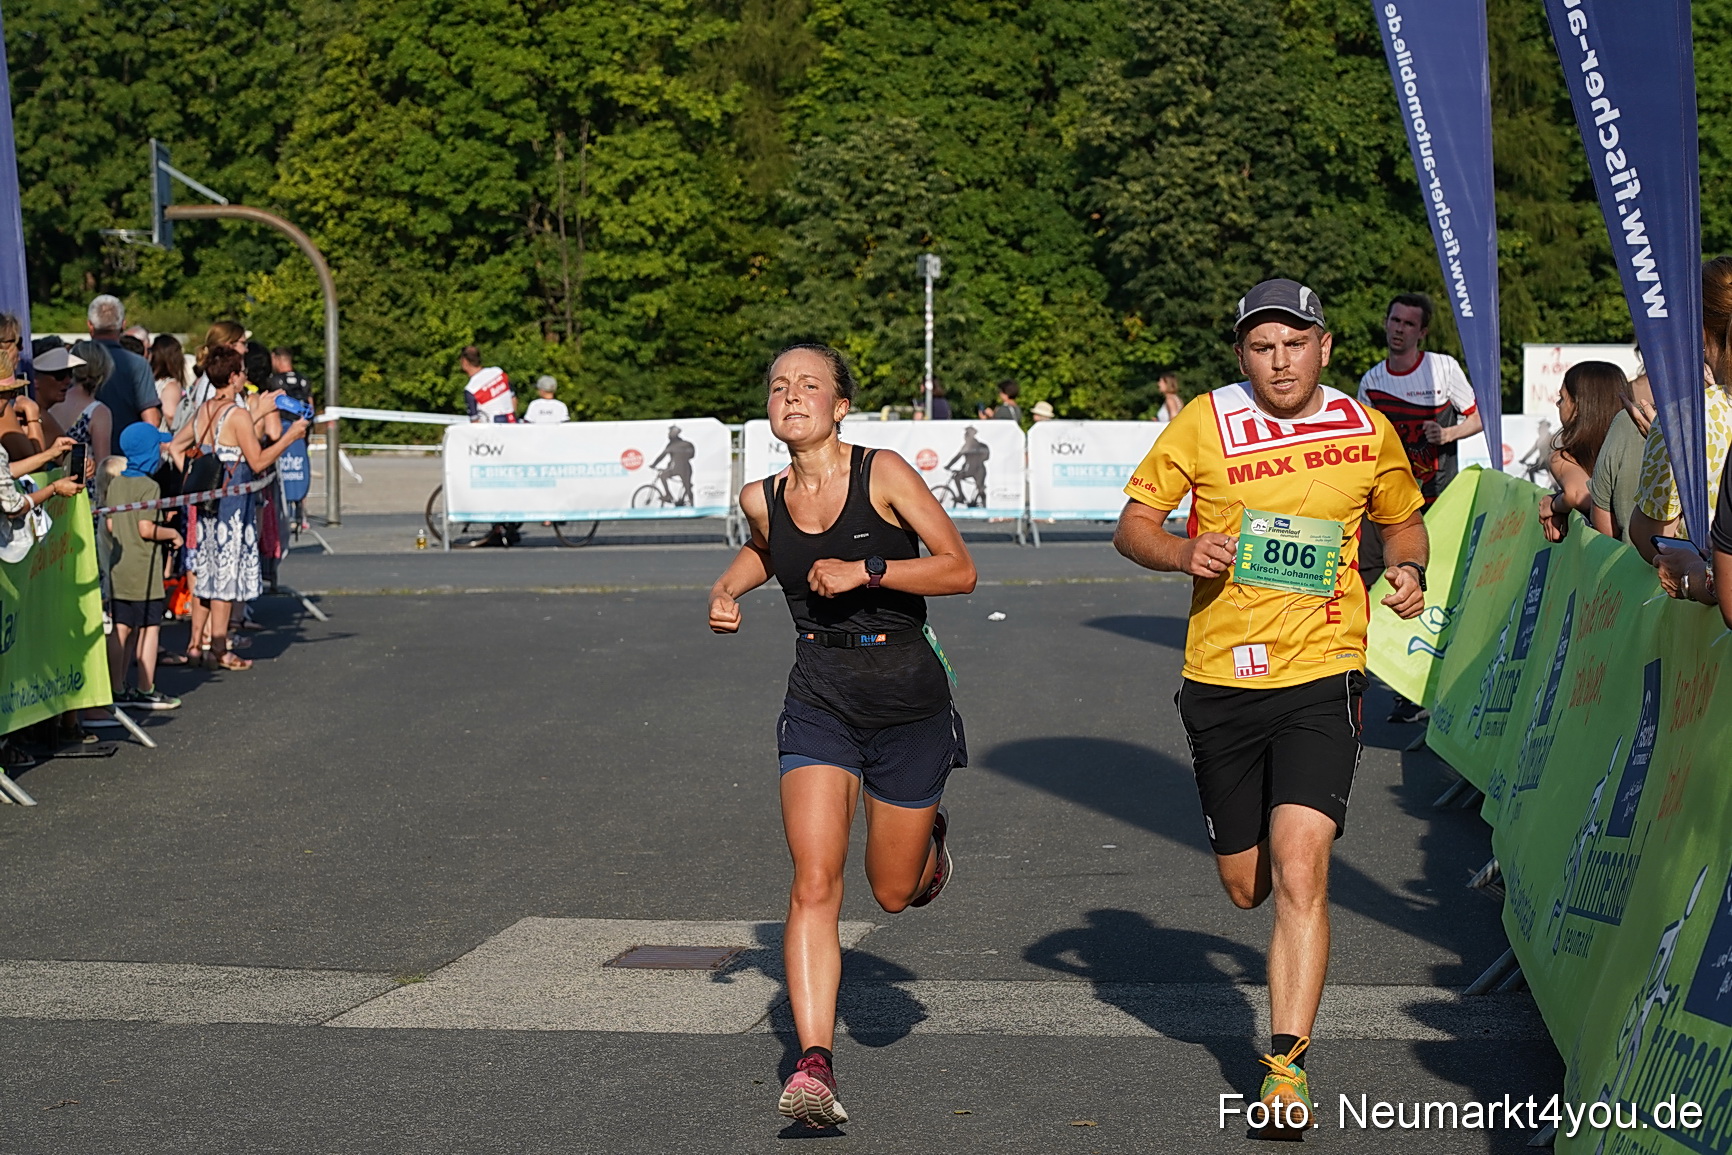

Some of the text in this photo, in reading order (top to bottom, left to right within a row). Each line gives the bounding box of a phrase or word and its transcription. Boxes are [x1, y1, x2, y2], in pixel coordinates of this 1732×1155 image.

[468, 443, 504, 456] NOW
[1051, 442, 1085, 455] NOW
[472, 466, 524, 478] E-BIKES
[527, 466, 538, 477] &
[1106, 465, 1117, 477] &
[1227, 444, 1377, 485] MAX BÖGL
[1269, 526, 1301, 535] Firmenlauf
[1241, 543, 1254, 570] RUN
[1264, 539, 1317, 569] 806
[1250, 562, 1324, 581] Kirsch Johannes
[1323, 551, 1336, 586] 2022
